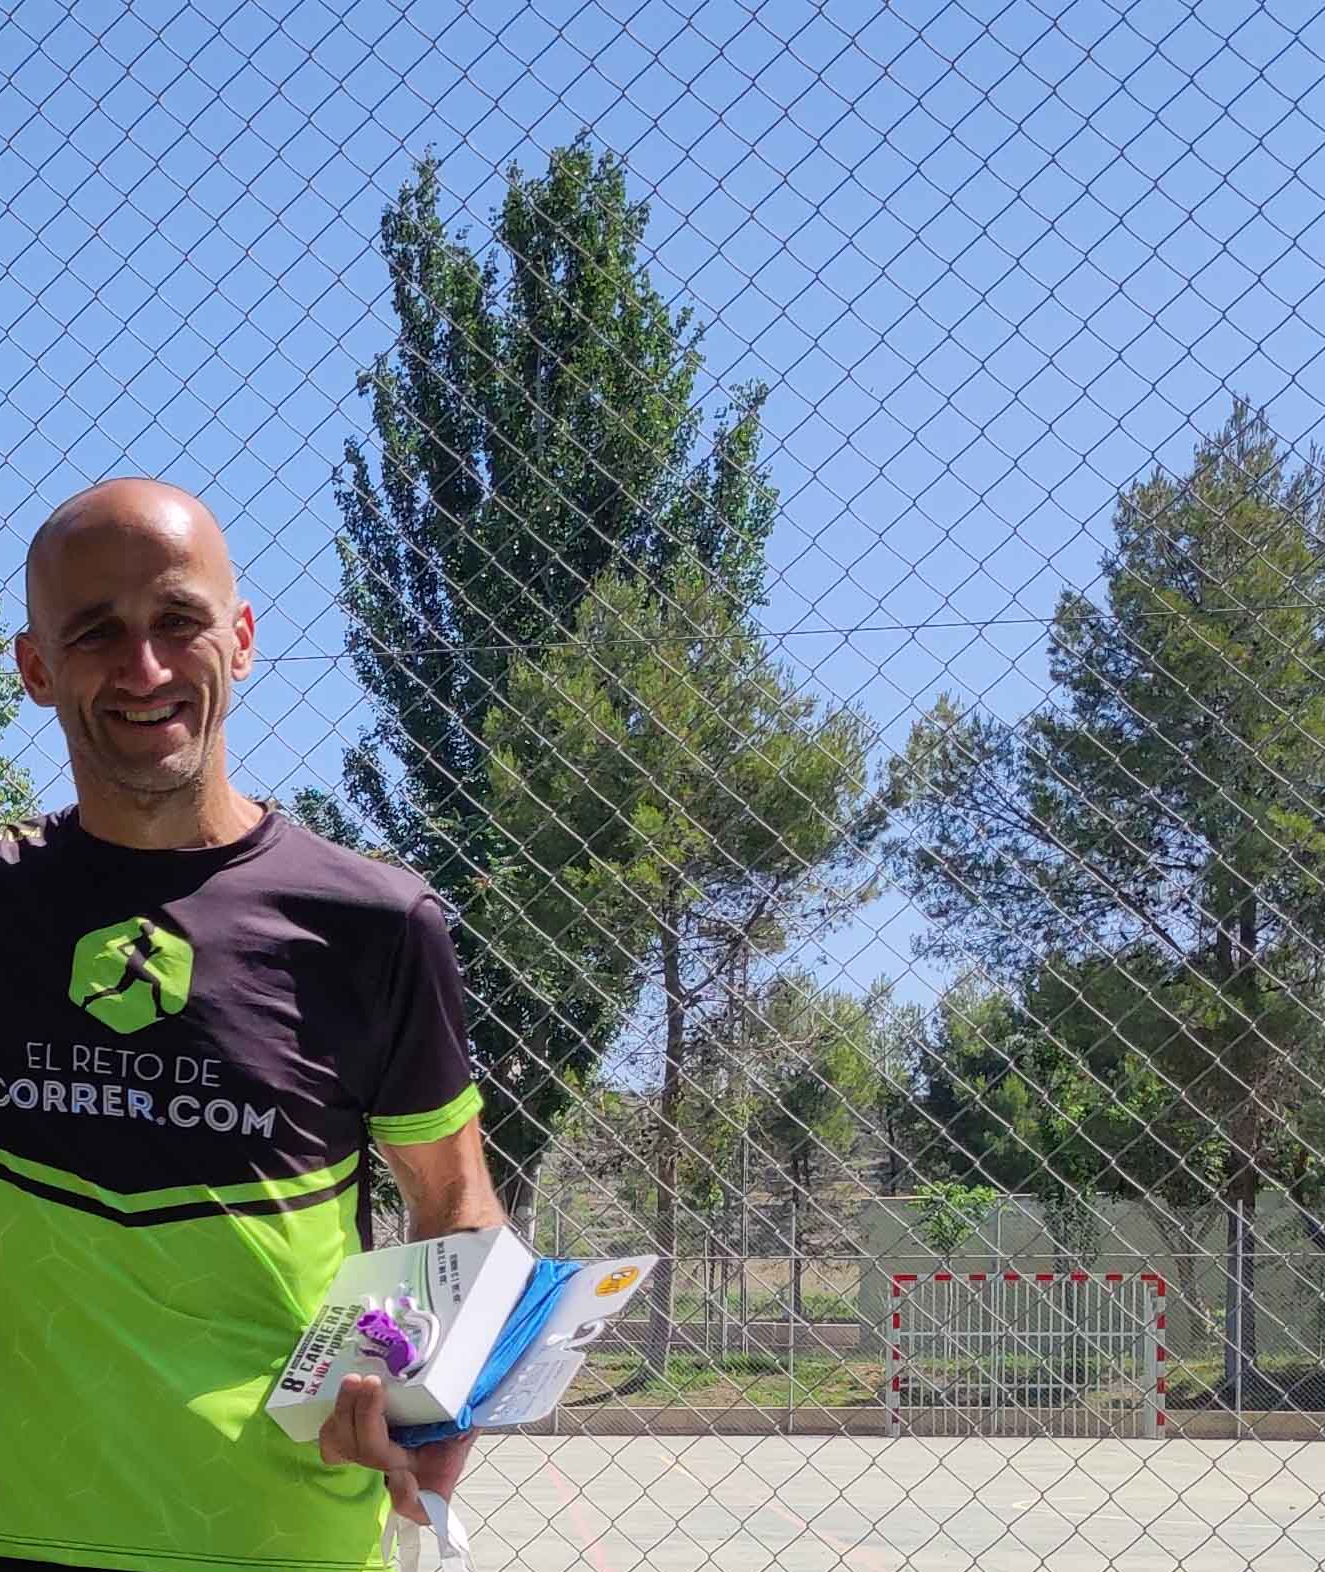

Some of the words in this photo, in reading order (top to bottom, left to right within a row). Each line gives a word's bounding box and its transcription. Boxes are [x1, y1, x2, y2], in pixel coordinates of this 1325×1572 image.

[26, 1041, 62, 1071] EL
[71, 1044, 164, 1081] RETO
[174, 1055, 222, 1088] DE
